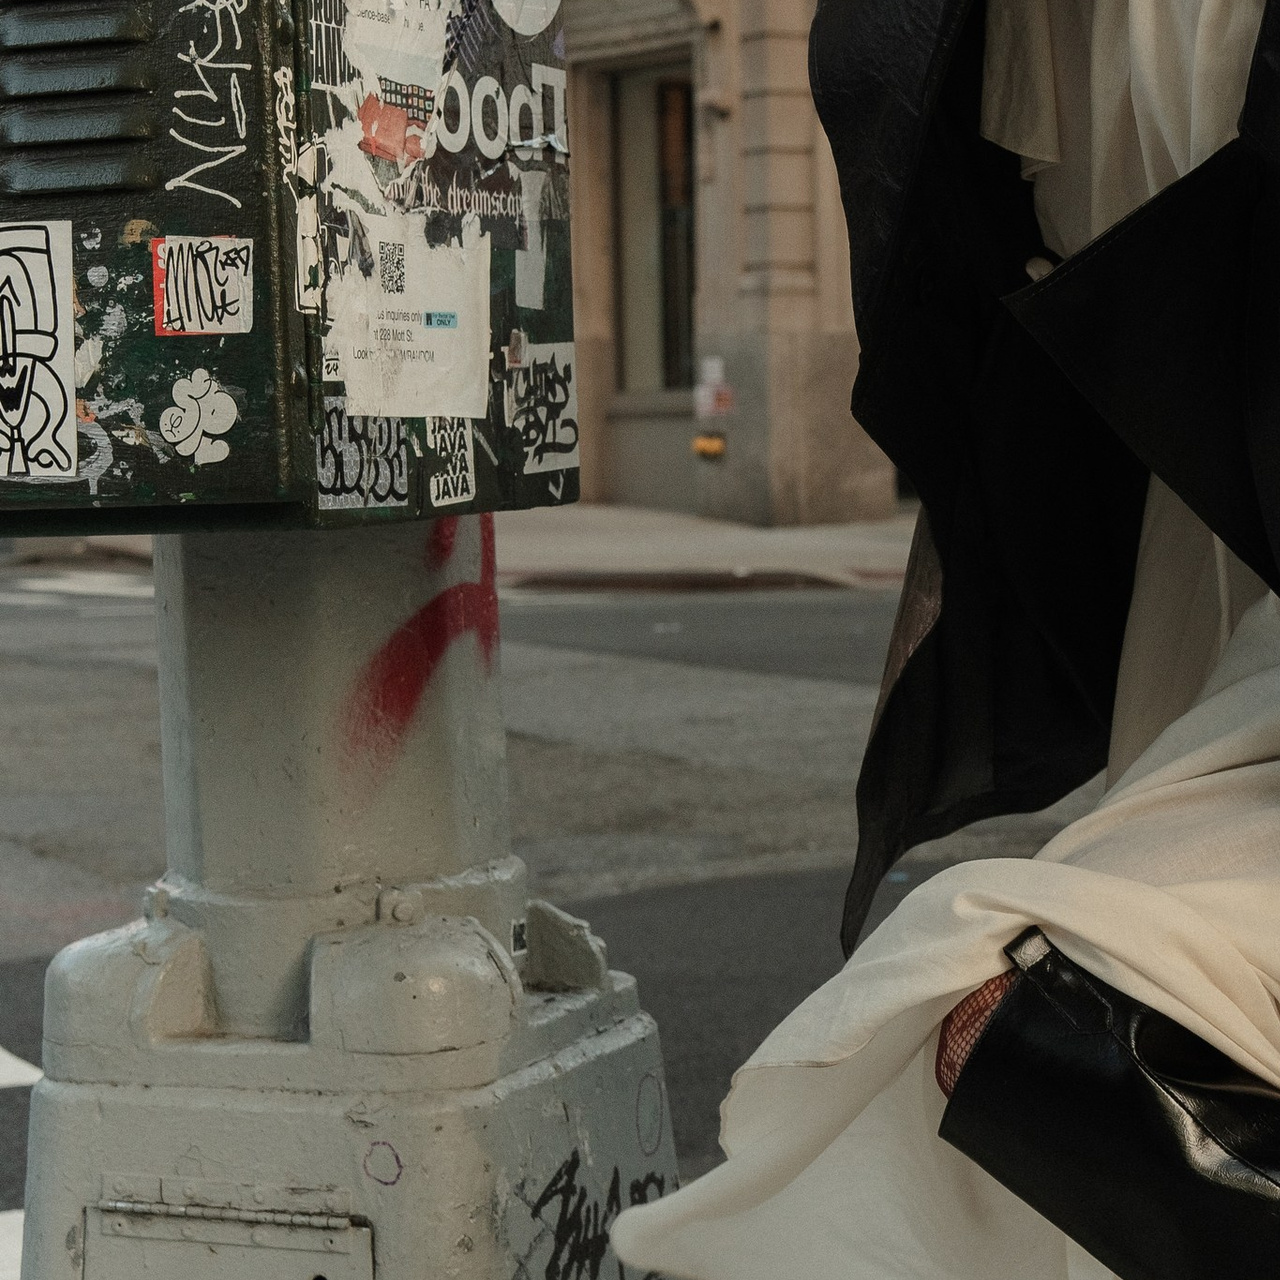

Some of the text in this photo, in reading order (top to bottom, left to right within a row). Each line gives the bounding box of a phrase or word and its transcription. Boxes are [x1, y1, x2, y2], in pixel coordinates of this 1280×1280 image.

[385, 307, 410, 324] inquiries
[410, 309, 423, 326] only
[437, 319, 451, 327] ONLY
[379, 328, 392, 342] 228
[392, 328, 406, 343] Mott
[406, 328, 414, 343] St.
[352, 346, 368, 360] Look
[434, 473, 470, 501] JAVA
